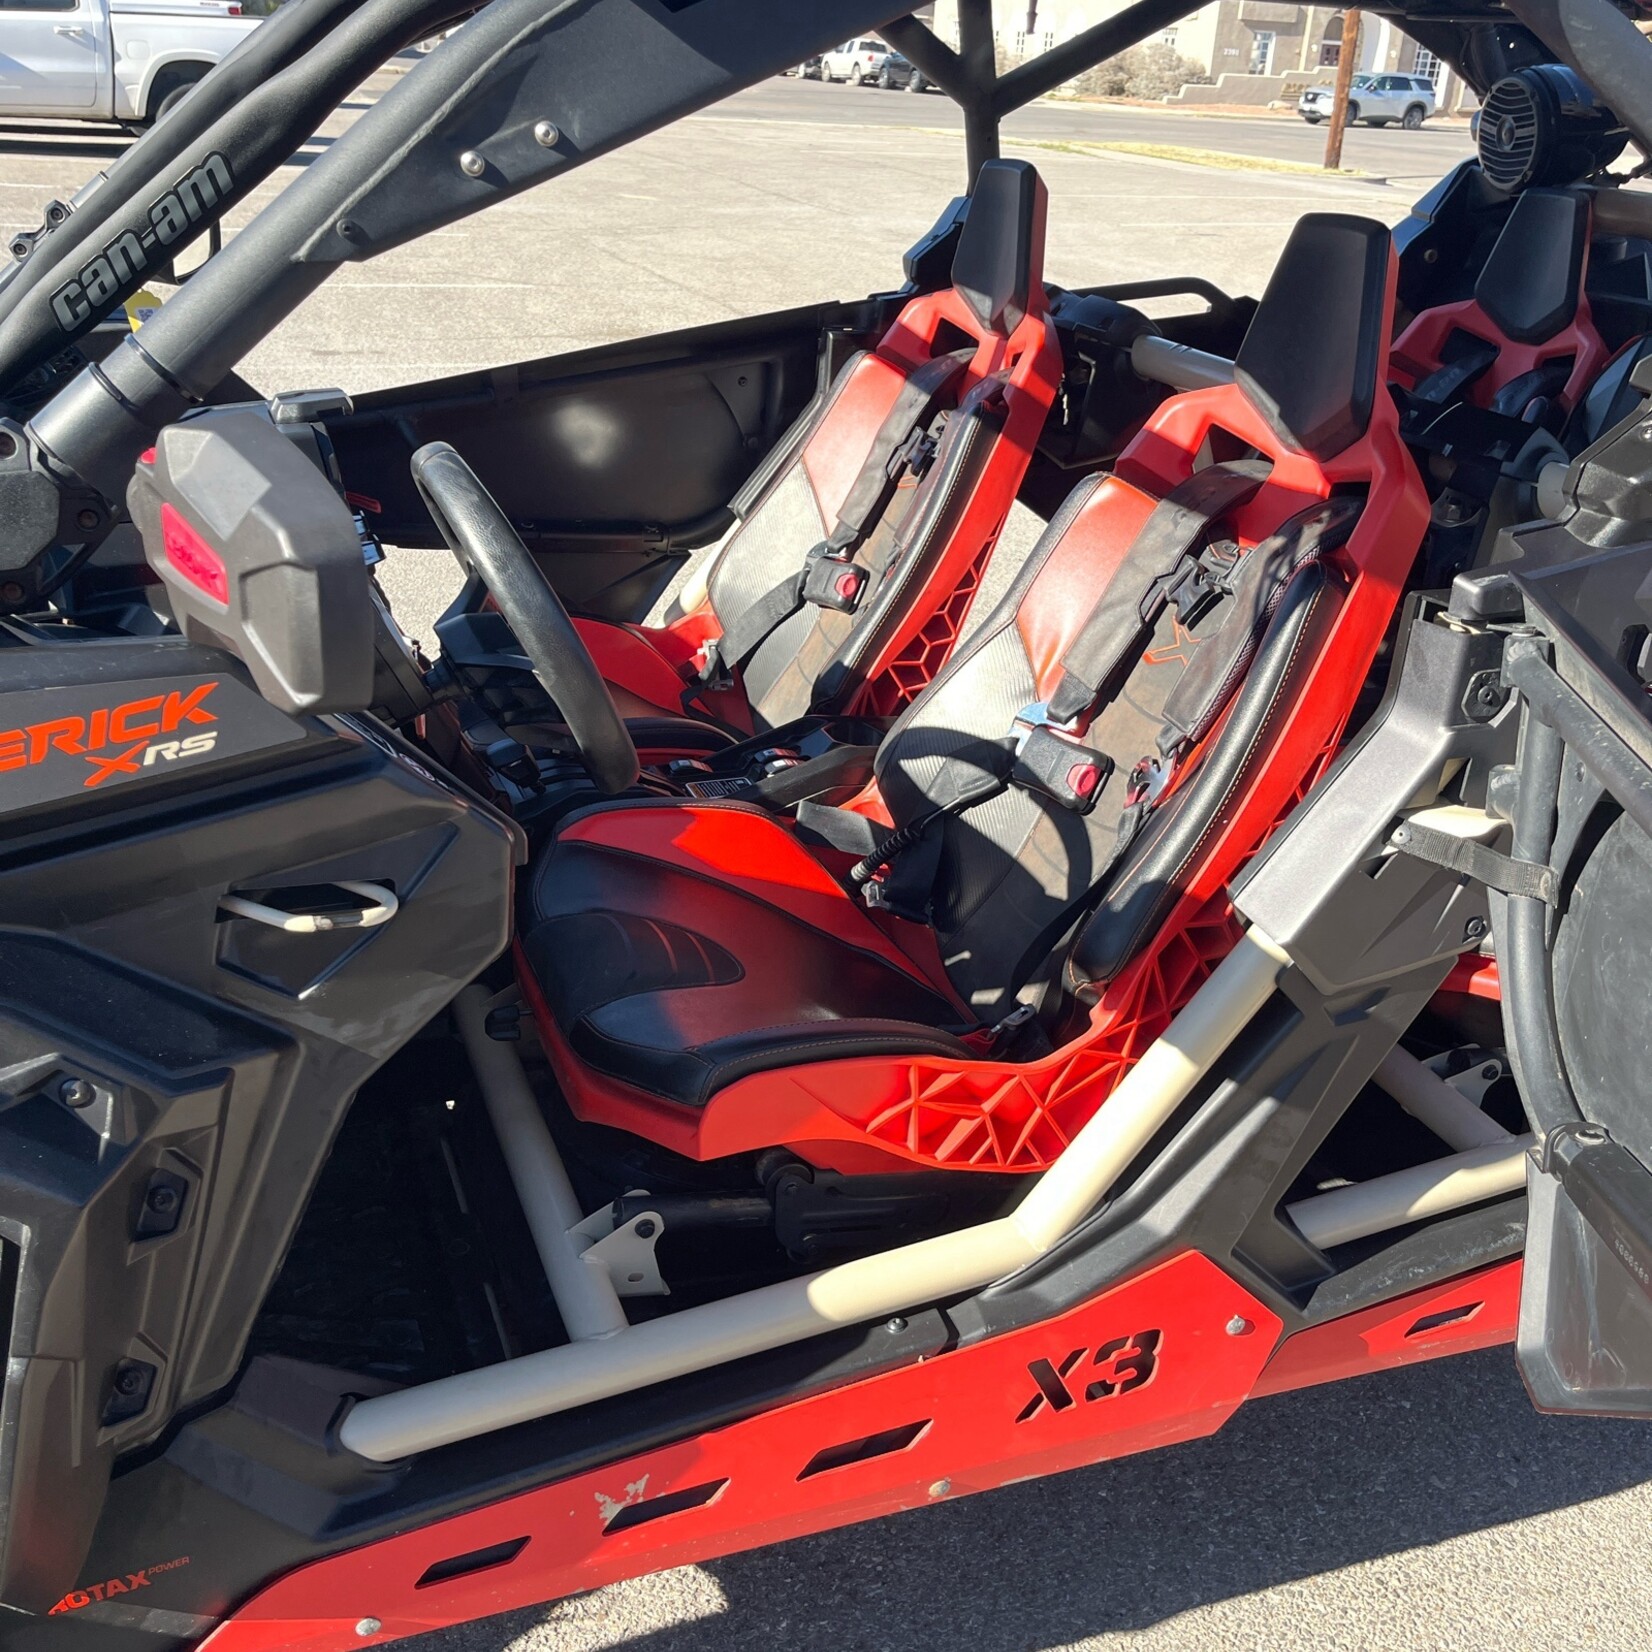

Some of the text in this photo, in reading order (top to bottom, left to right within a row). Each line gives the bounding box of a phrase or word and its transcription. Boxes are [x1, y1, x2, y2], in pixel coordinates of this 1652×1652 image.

[50, 152, 234, 332] can-am
[1014, 1328, 1164, 1424] X3
[148, 1556, 190, 1576] POWER
